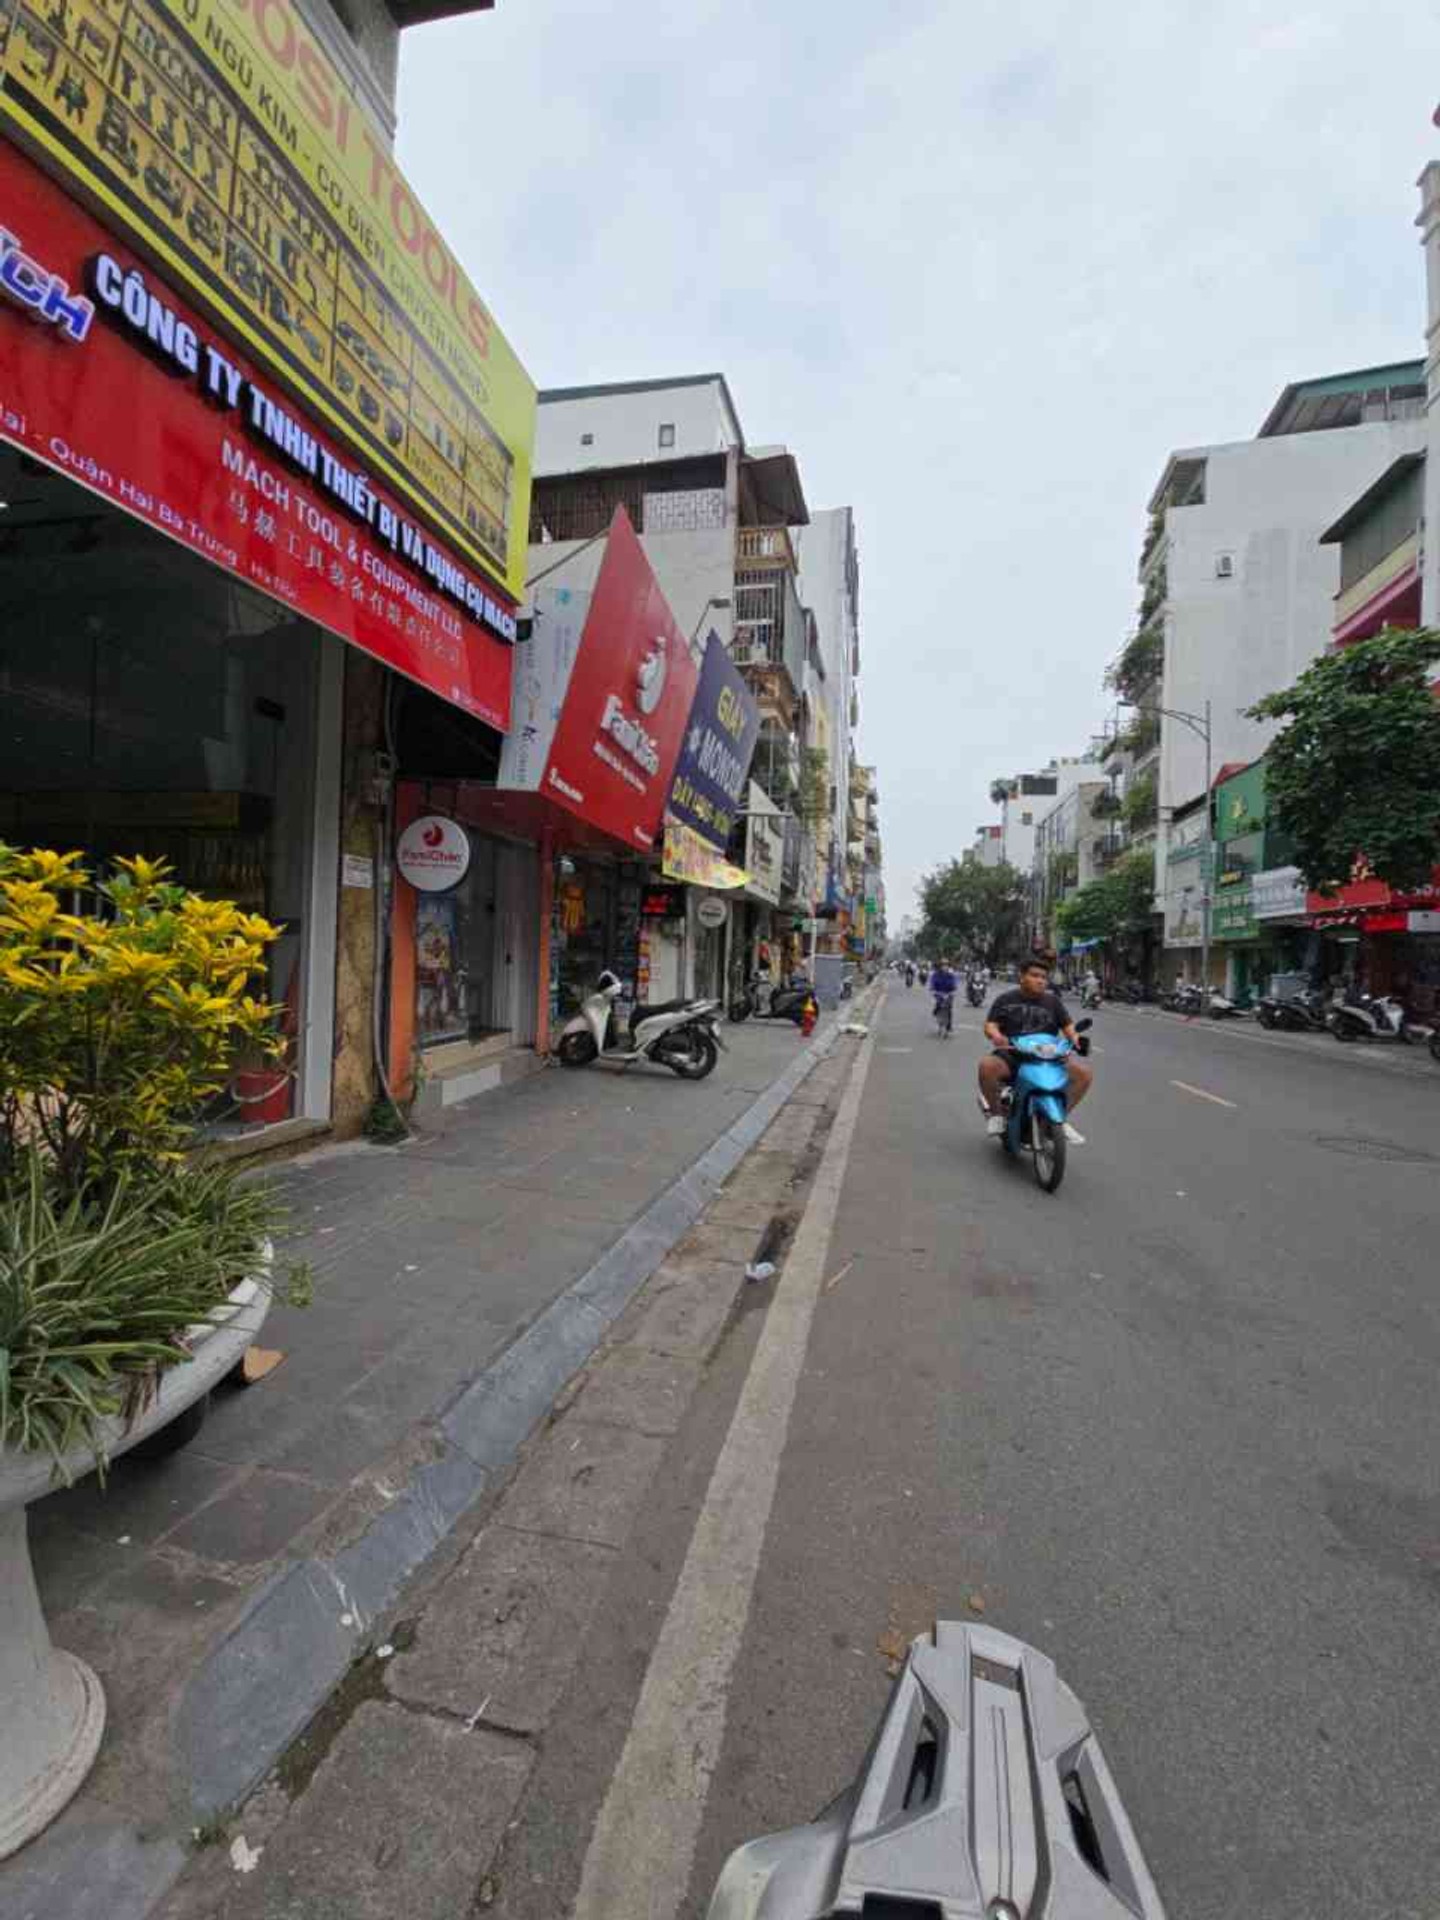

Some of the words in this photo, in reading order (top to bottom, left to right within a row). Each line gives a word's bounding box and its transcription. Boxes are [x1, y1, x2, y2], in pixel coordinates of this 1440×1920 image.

[238, 0, 350, 153] OSI
[362, 127, 492, 360] TOOLS
[258, 84, 298, 153] KIM
[50, 437, 113, 489] Quận
[120, 478, 153, 513] Hai
[159, 501, 184, 531] Bà
[95, 253, 199, 375] CÔNG
[206, 345, 243, 409] TY
[249, 385, 318, 477] TNHH
[320, 444, 379, 523] THIẾT
[379, 494, 398, 553] BỊ
[402, 522, 424, 565] VÀ
[425, 546, 465, 602] DỤNG
[221, 439, 290, 512] MACH
[294, 496, 342, 553] TOOL
[347, 539, 358, 561] &
[362, 550, 441, 624] EQUIPMENT
[442, 612, 463, 640] LLC
